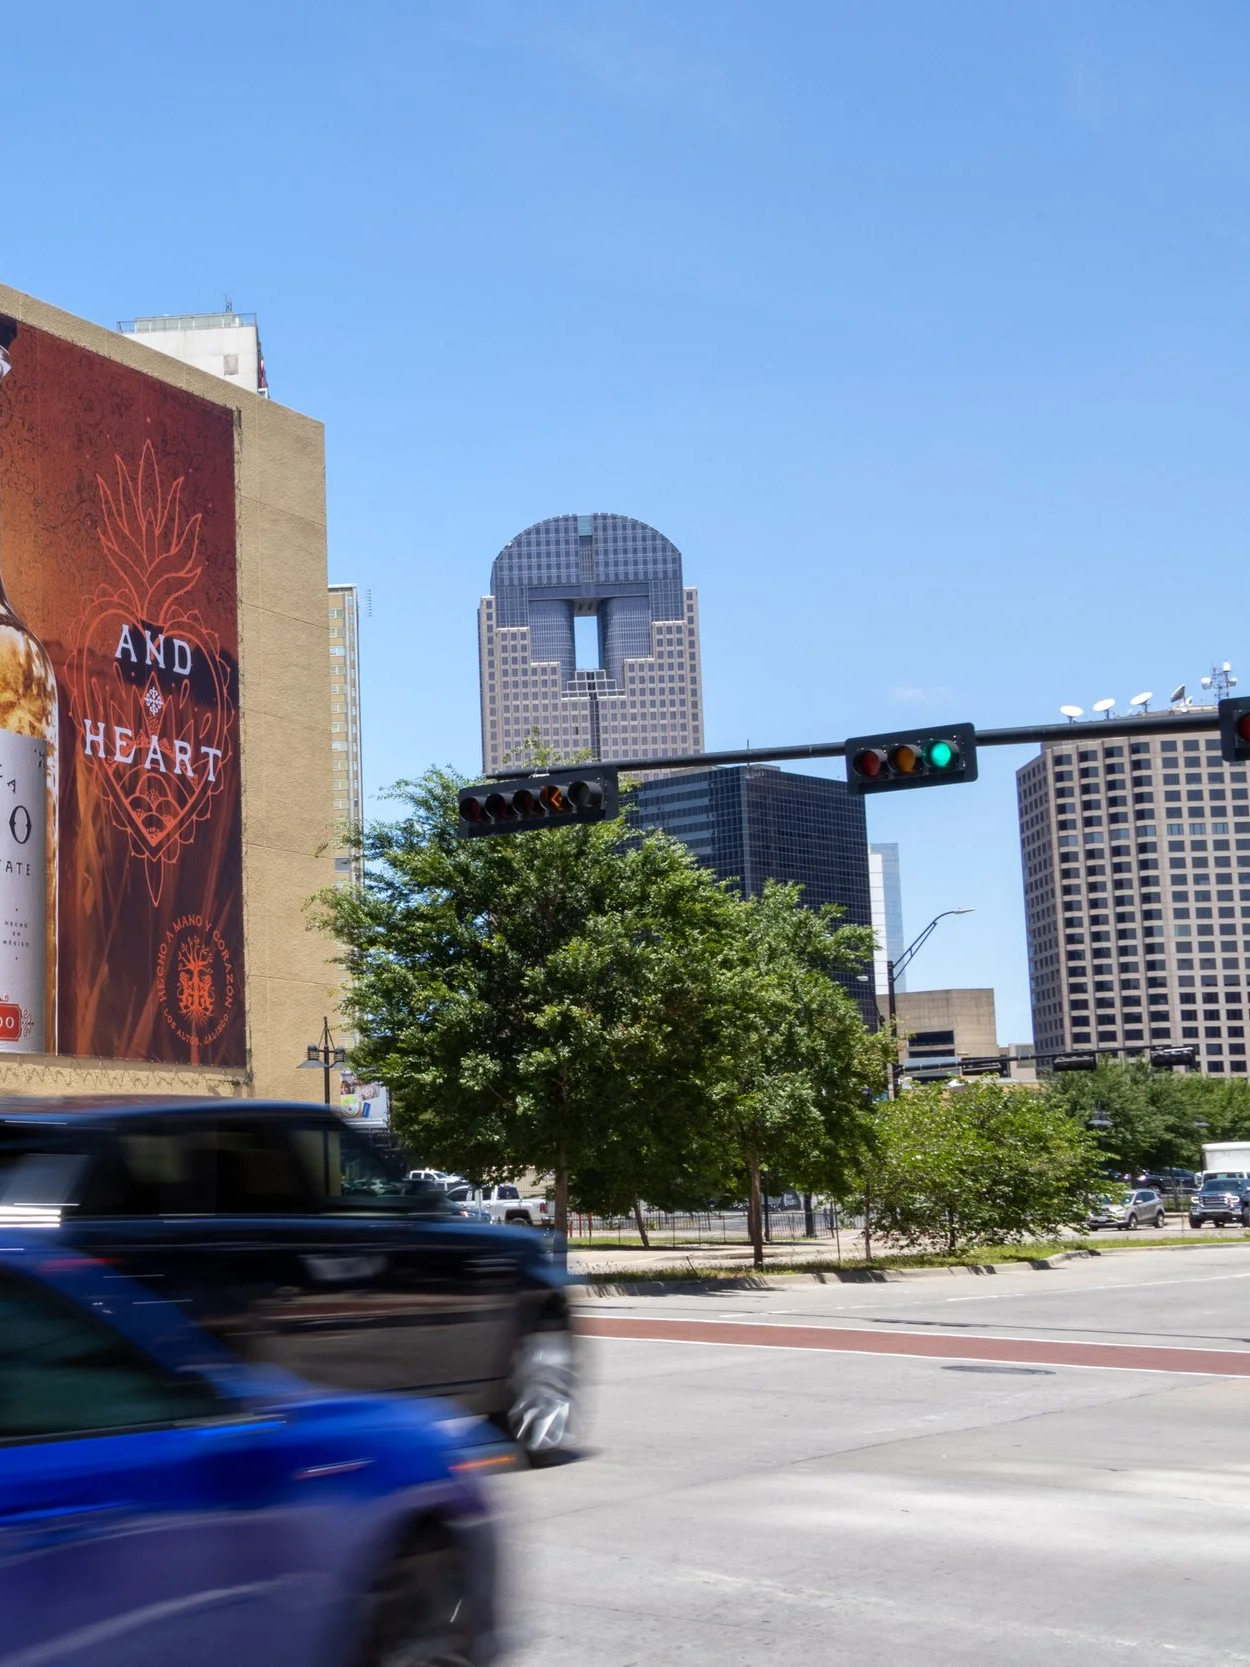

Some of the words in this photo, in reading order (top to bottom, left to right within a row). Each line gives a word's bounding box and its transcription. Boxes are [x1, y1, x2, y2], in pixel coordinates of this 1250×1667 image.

[114, 624, 192, 675] AND
[83, 718, 222, 782] HEART
[156, 943, 168, 1002] HECHO
[166, 931, 174, 943] A
[172, 913, 203, 933] MANO
[205, 920, 212, 932] Y
[203, 1014, 229, 1045] JALISCO
